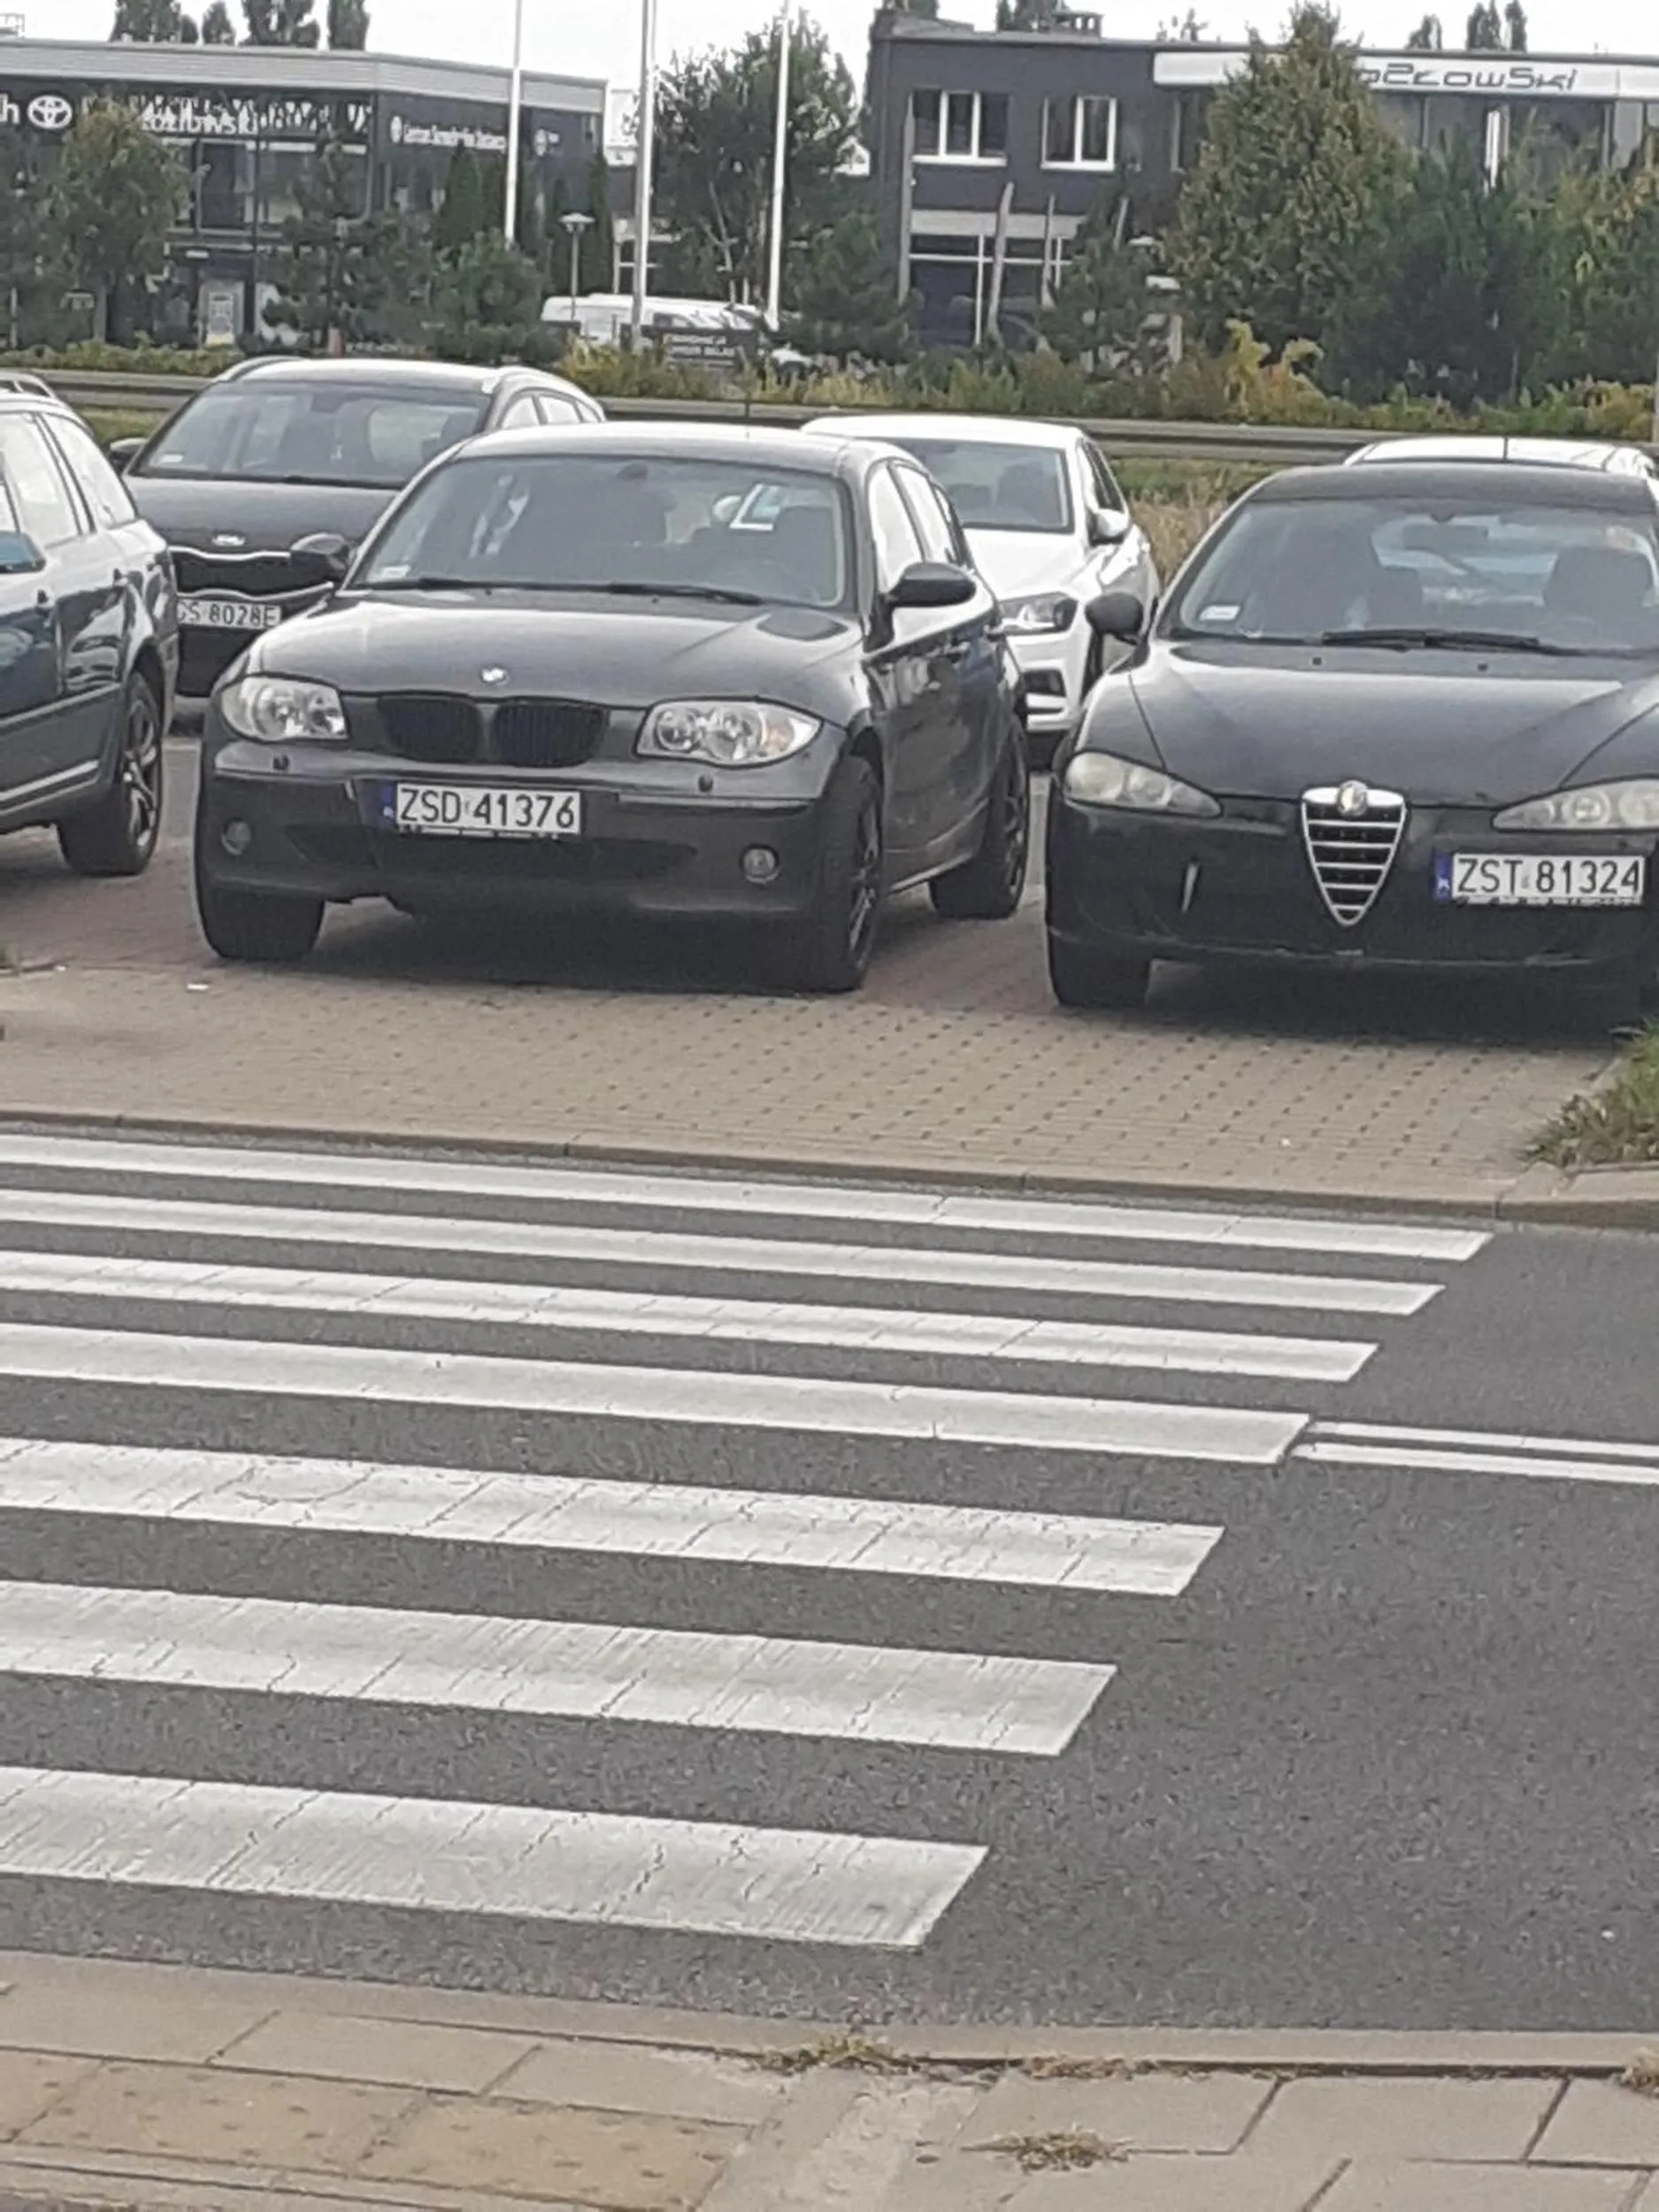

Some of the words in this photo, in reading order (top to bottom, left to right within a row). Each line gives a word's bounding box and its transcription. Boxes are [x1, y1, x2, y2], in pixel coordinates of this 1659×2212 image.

[400, 787, 462, 824] ZSD
[472, 793, 575, 829] 41376
[1457, 857, 1524, 895] ZST
[1535, 859, 1640, 895] 81324
